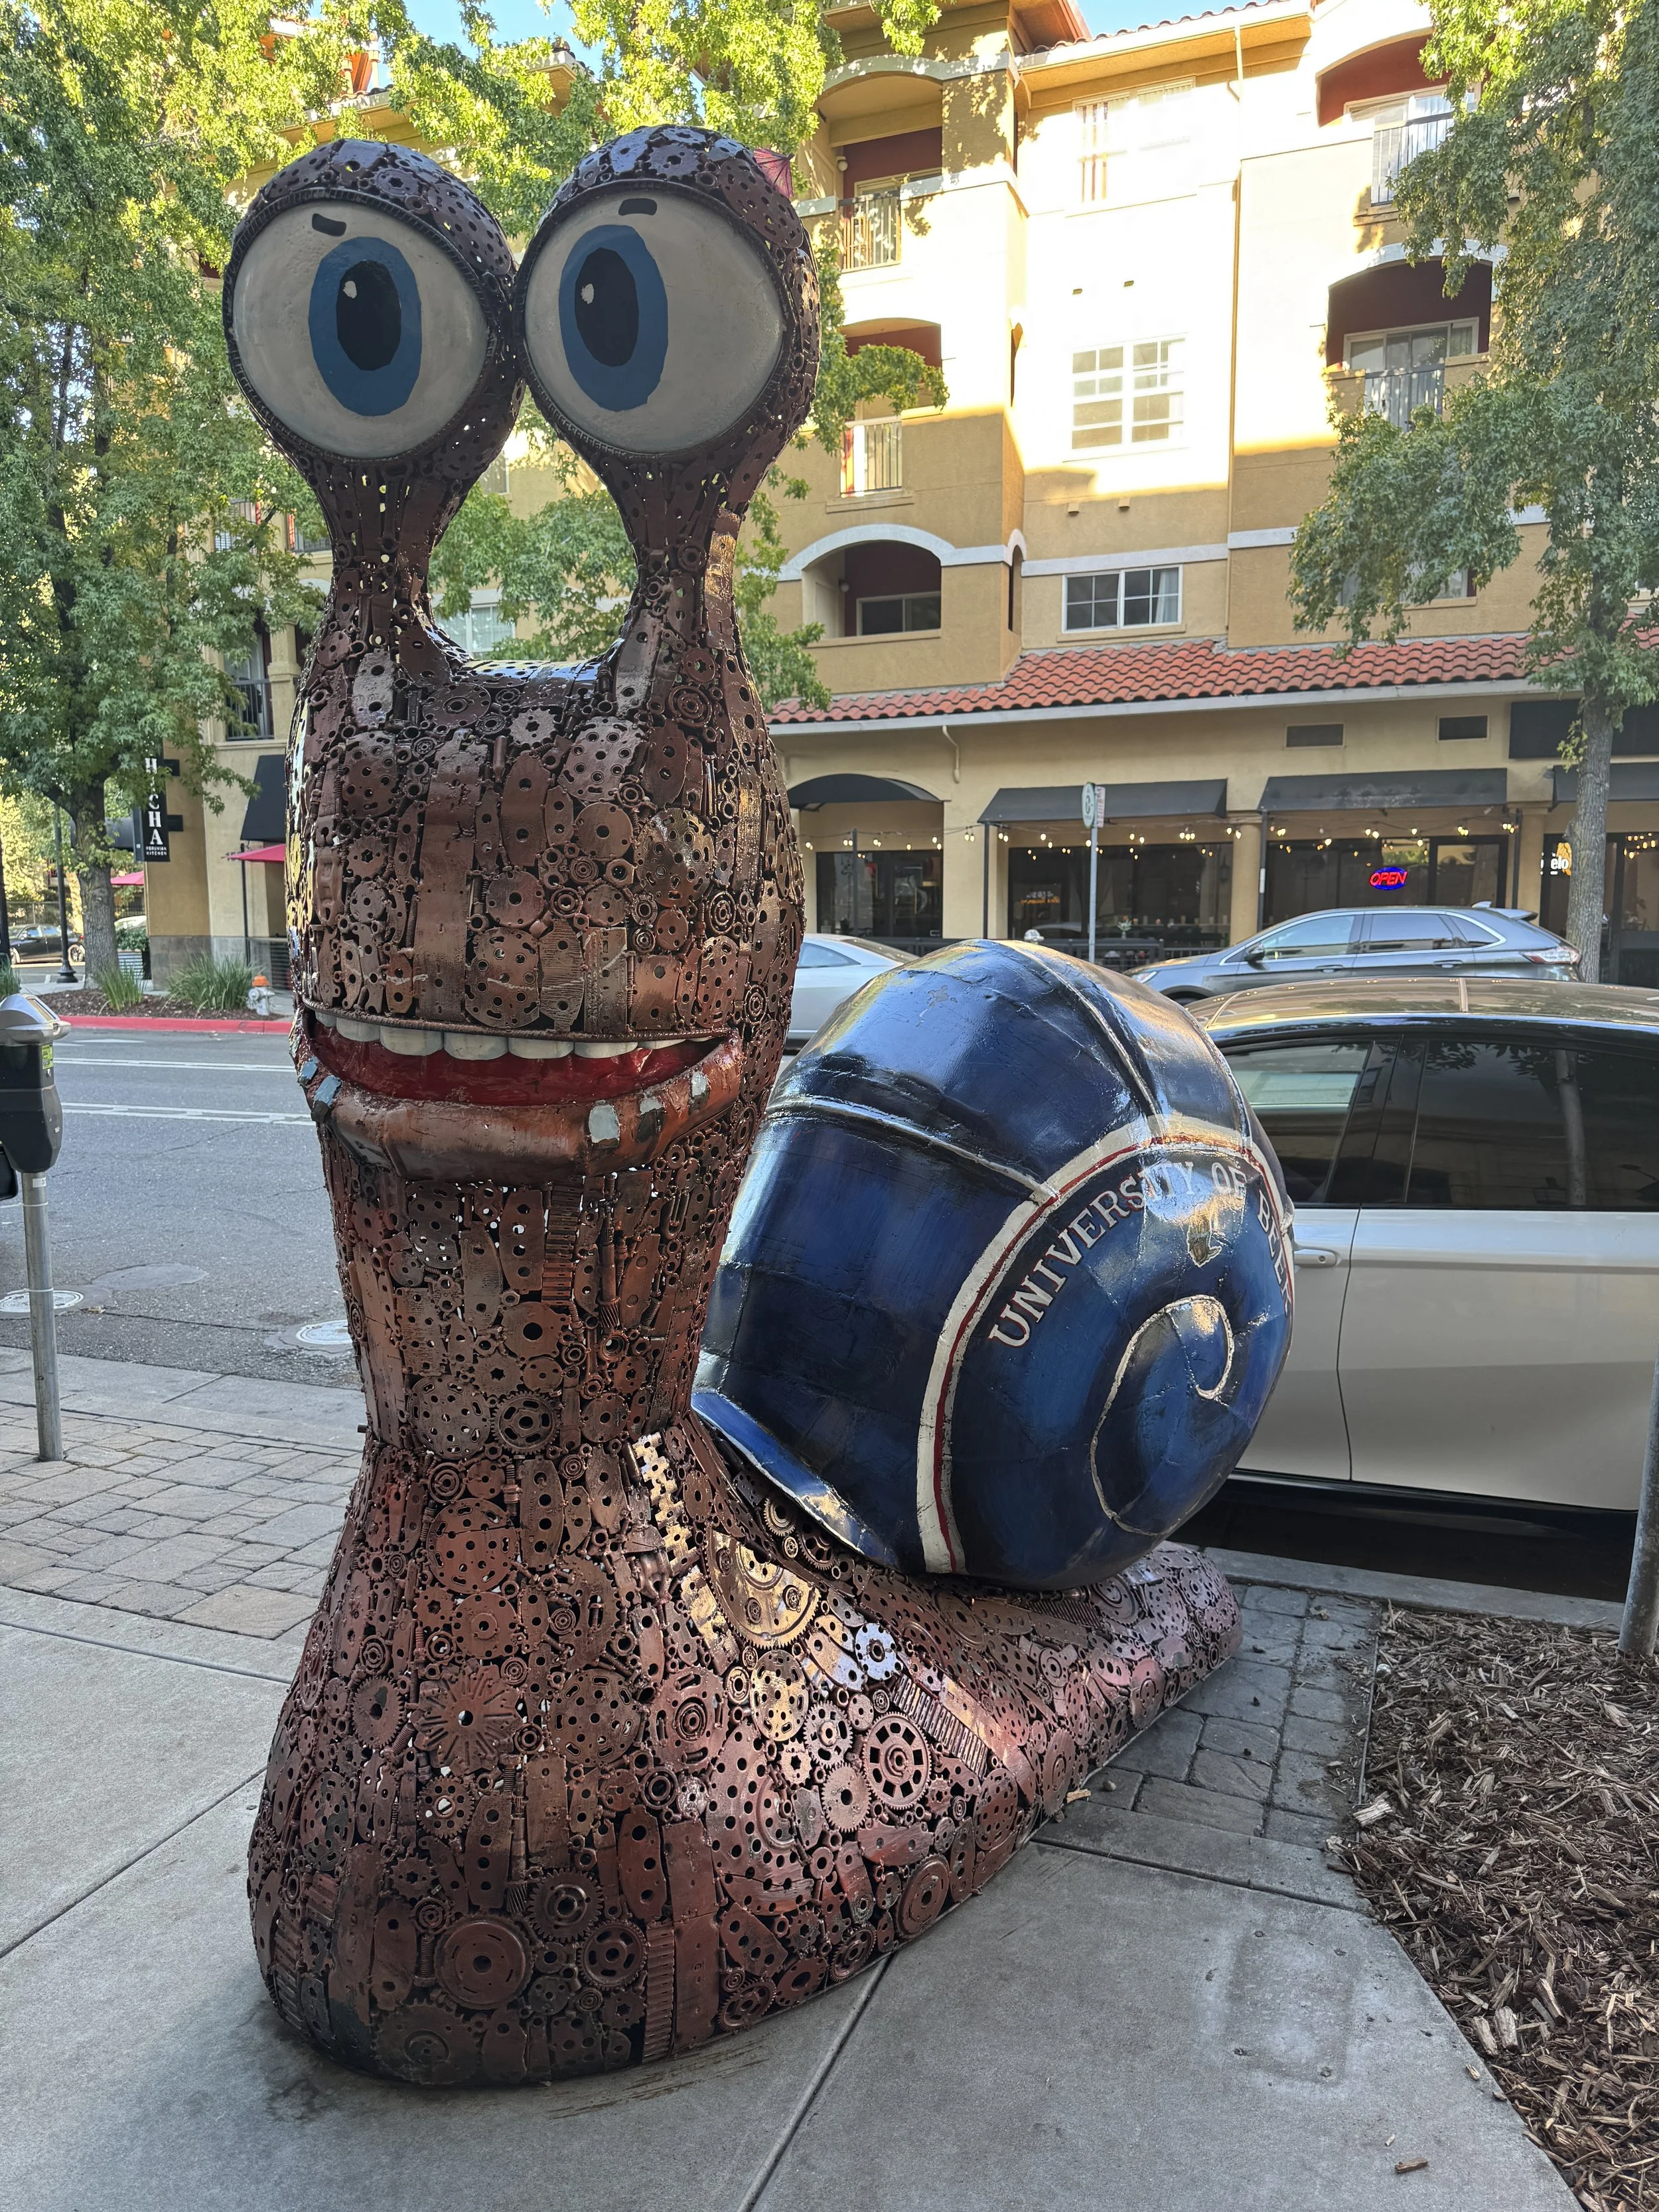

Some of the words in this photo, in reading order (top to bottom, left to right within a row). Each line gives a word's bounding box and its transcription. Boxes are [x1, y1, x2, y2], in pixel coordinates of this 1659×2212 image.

[1370, 871, 1407, 886] OPEN
[988, 1161, 1194, 1348] UNIVERSITY
[1212, 1162, 1248, 1198] OF
